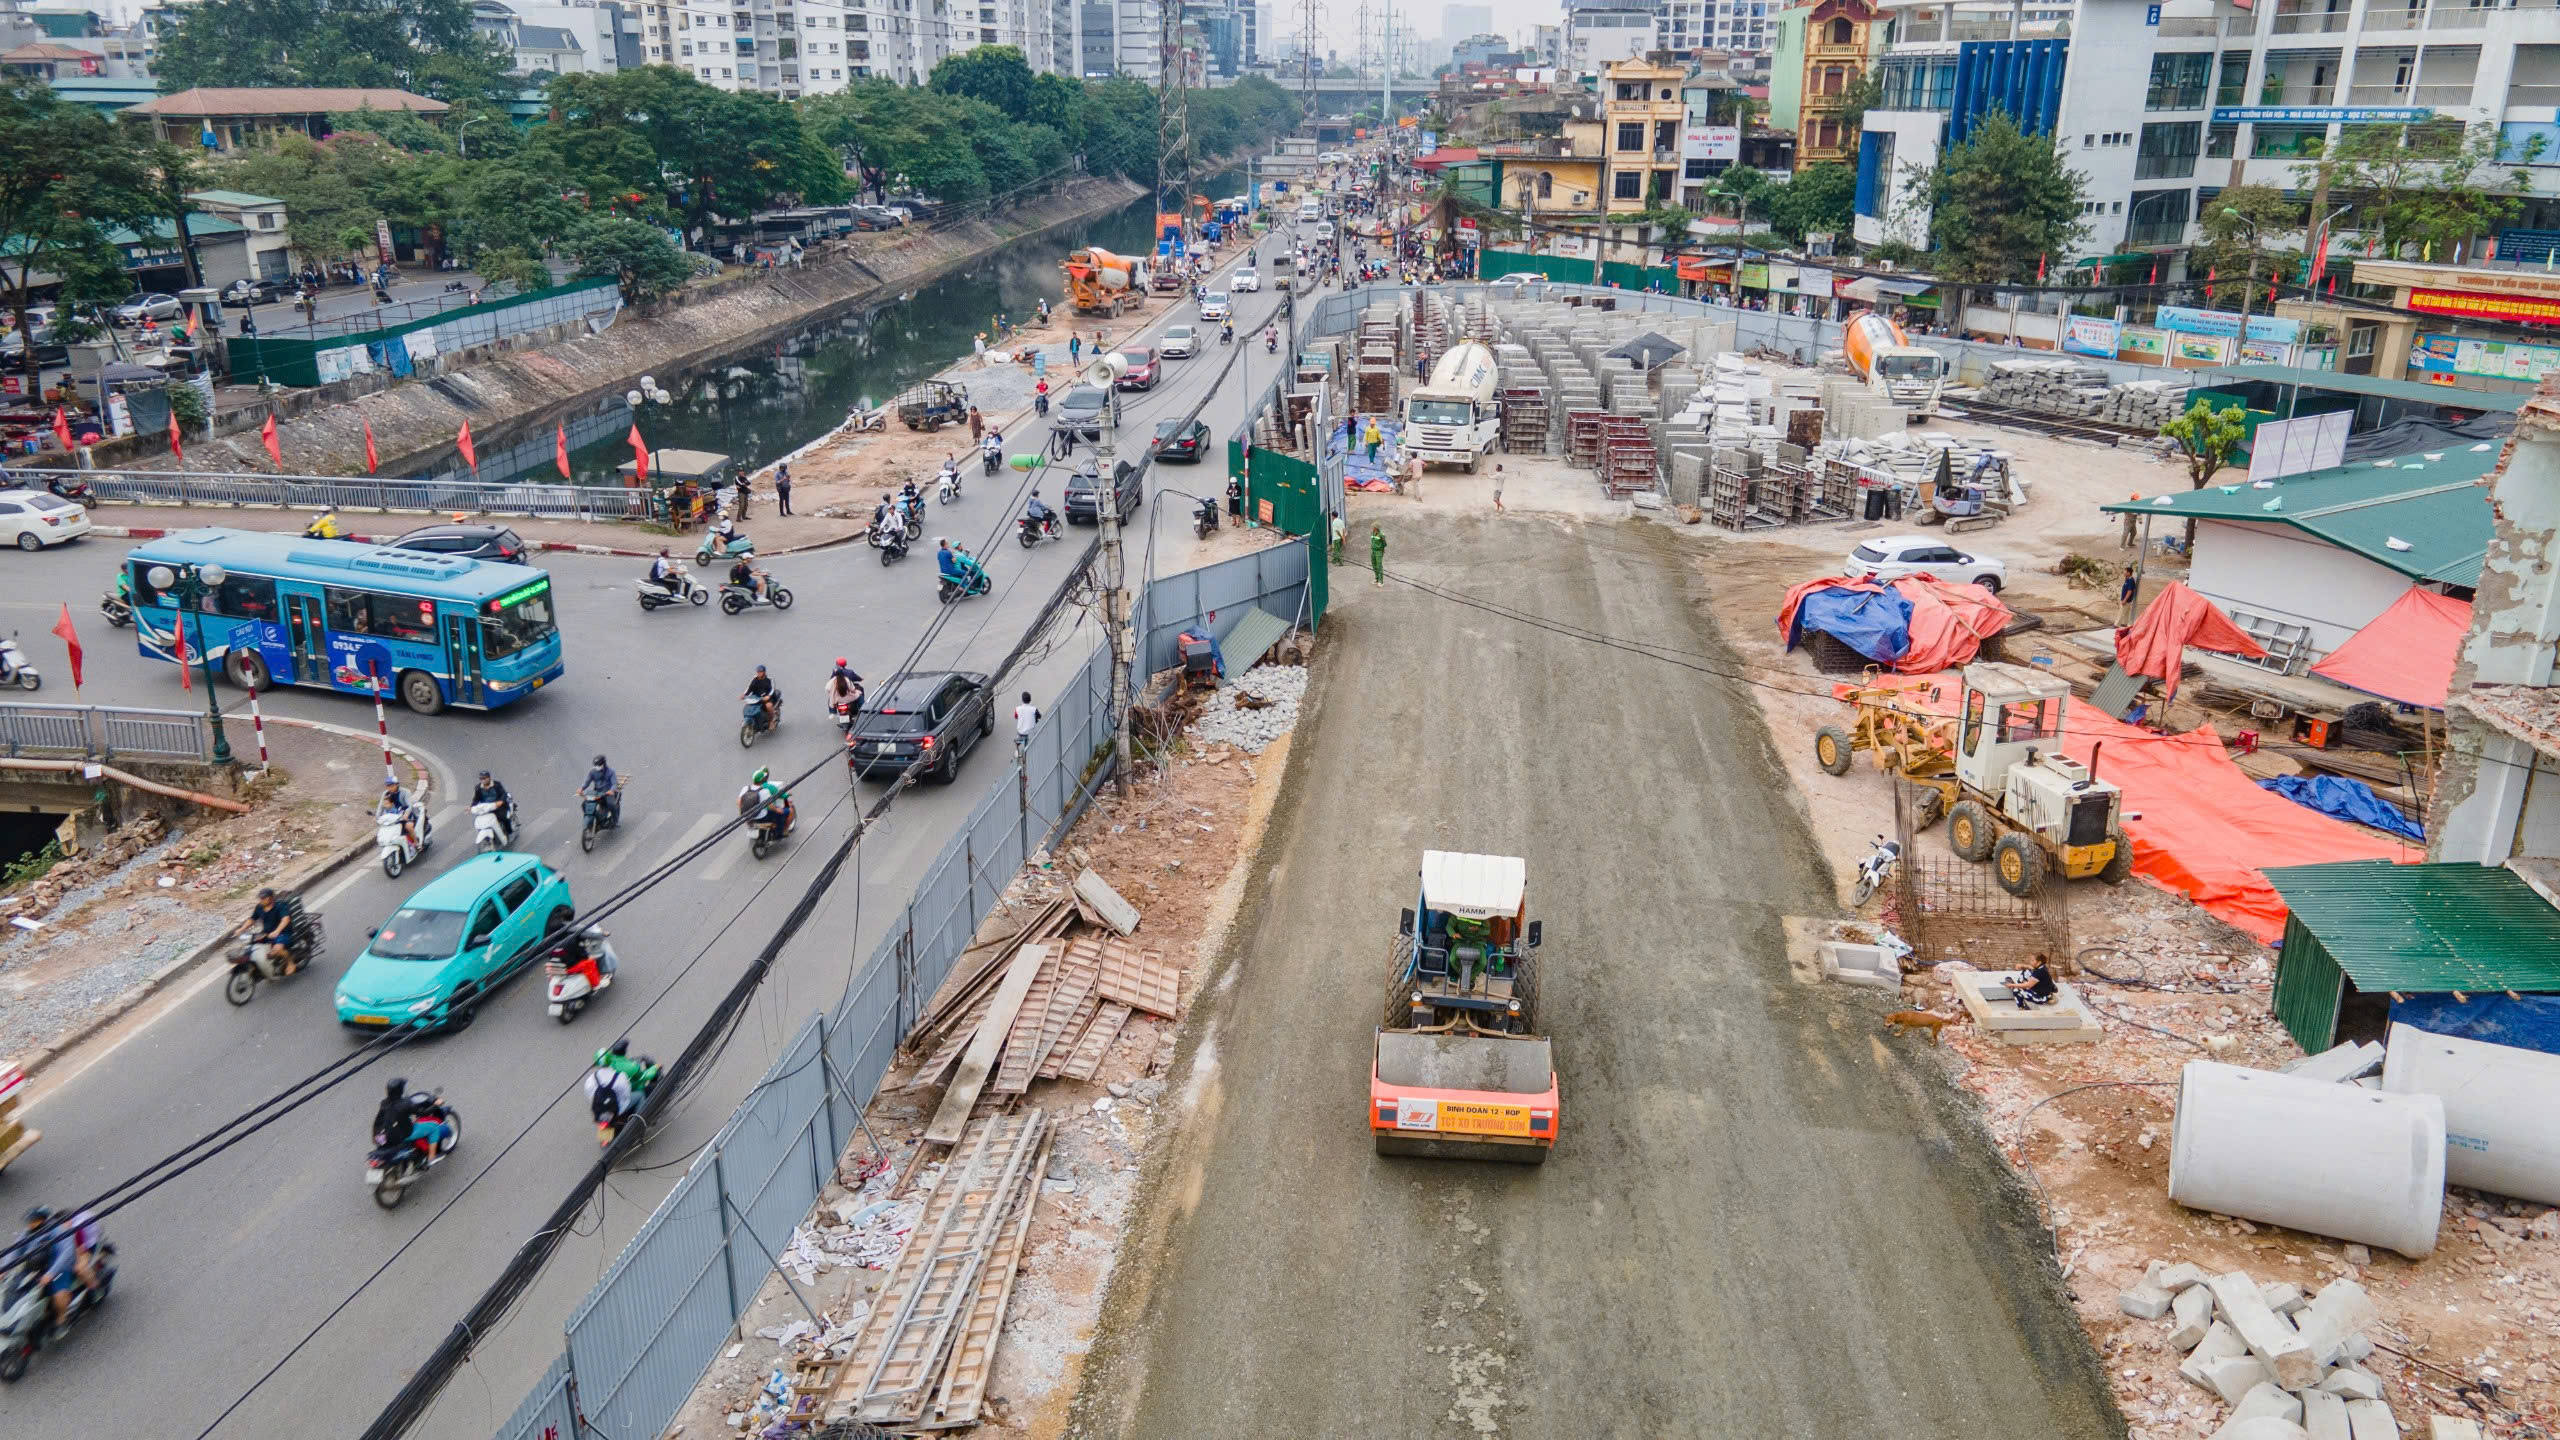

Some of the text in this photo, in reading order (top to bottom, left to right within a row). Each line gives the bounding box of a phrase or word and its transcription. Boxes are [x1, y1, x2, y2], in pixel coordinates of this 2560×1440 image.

[1459, 907, 1486, 915] HAMM
[1446, 1105, 1464, 1113] BINH
[1490, 1107, 1499, 1115] 12
